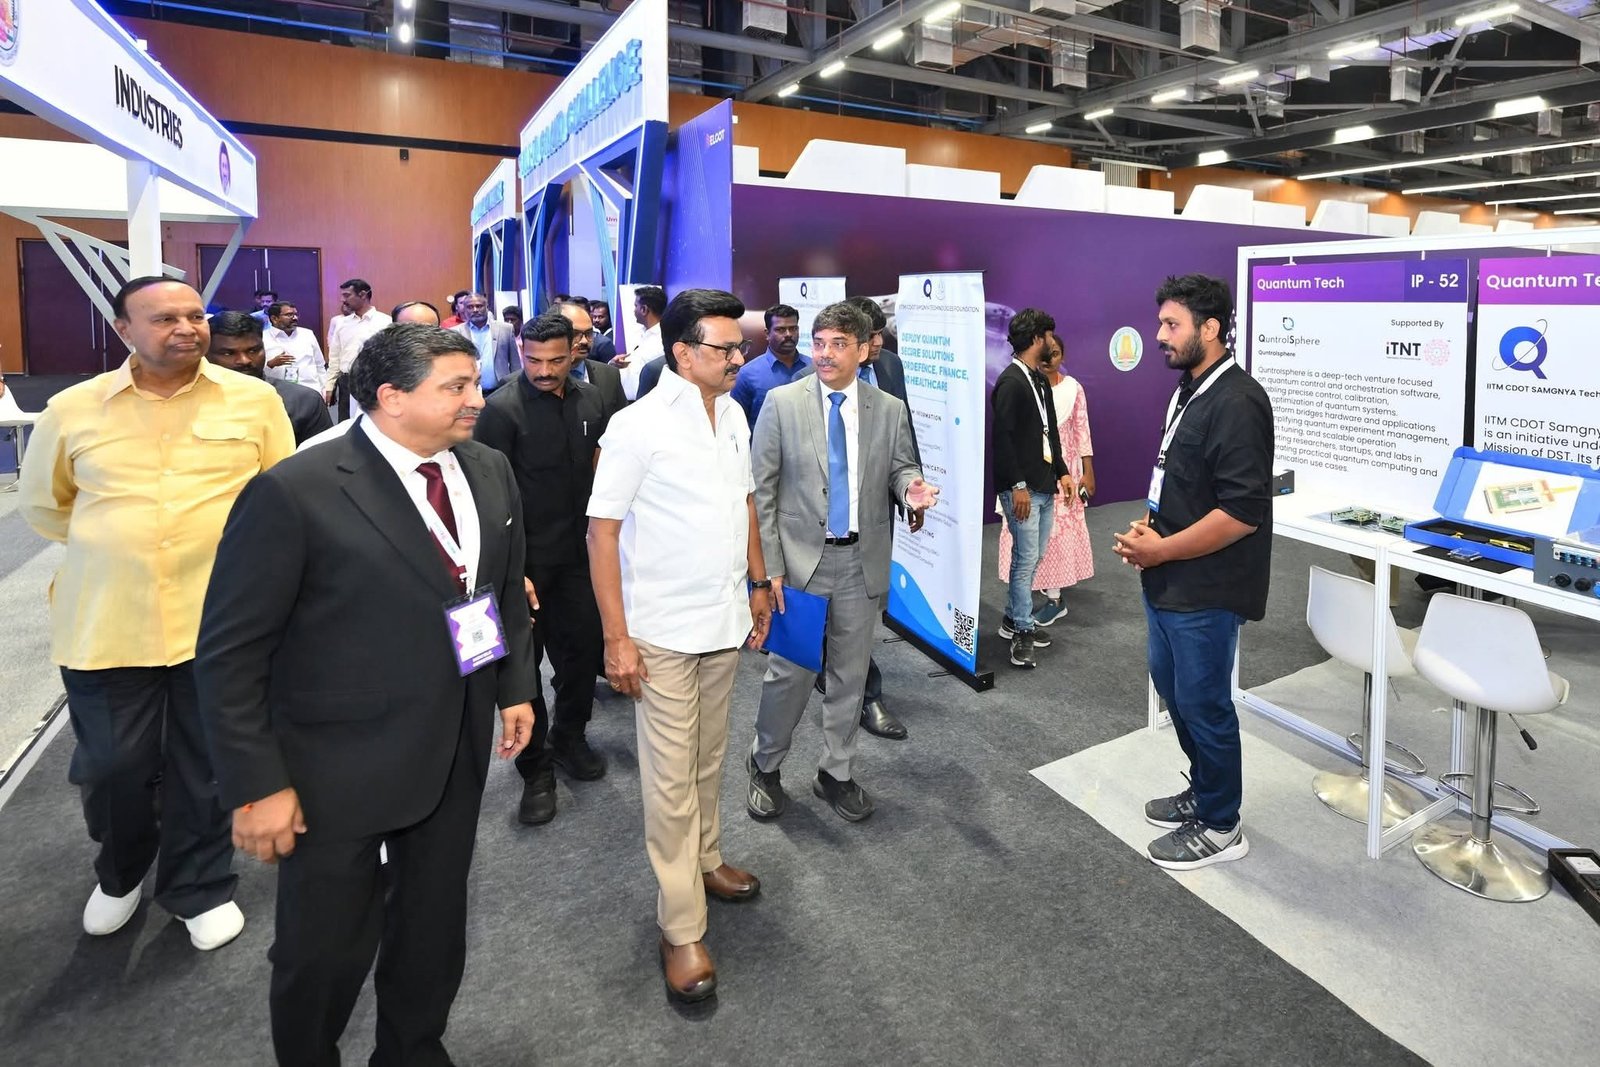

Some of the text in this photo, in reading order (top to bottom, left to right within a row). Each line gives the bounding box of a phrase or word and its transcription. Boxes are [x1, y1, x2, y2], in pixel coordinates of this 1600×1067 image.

[114, 64, 183, 149] INDUSTRIES
[1257, 276, 1345, 291] Quantum Tech
[1411, 274, 1425, 288] IP
[1439, 273, 1459, 288] 52
[1486, 274, 1578, 290] Quantum
[1391, 319, 1444, 329] Supported By
[901, 333, 951, 346] DEPLOY QUANTUM
[1258, 334, 1321, 346] QuntrolSphere
[1385, 341, 1421, 356] iTNT
[901, 347, 954, 363] SECURE SOLUTIONS
[911, 376, 948, 392] HEALTHCARE
[1258, 366, 1306, 377] Quntrolsphere
[1321, 372, 1362, 382] deep-tech
[1364, 376, 1395, 384] venture
[1397, 377, 1433, 388] focused
[1265, 387, 1287, 396] abling
[1288, 388, 1314, 397] precise
[1344, 394, 1389, 406] calibration,
[1267, 377, 1299, 385] quantum
[1300, 380, 1326, 388] control
[1327, 382, 1343, 390] and
[1344, 384, 1398, 395] orchestration
[1400, 389, 1441, 400] software,
[1505, 384, 1530, 393] CDOT
[1531, 386, 1577, 396] SAMGNYA
[1579, 390, 1600, 398] Tech
[1271, 396, 1315, 407] optimization
[1324, 403, 1360, 412] quantum
[1362, 406, 1398, 417] systems.
[1272, 406, 1436, 432] atform bridges hardware and applications
[1484, 415, 1600, 439] IITM CDOT Samgny
[1281, 425, 1305, 436] tuning,
[1306, 429, 1321, 438] and
[1322, 431, 1355, 443] scalable
[1356, 437, 1397, 449] operation
[1304, 420, 1338, 429] quantum
[1340, 424, 1385, 437] experiment
[1386, 430, 1450, 446] management,
[1484, 428, 1600, 451] is an initiative und
[1292, 437, 1338, 450] researchers,
[1339, 443, 1373, 456] startups,
[1375, 449, 1391, 459] and
[1393, 451, 1412, 462] labs
[1413, 454, 1422, 463] in
[1483, 442, 1528, 456] Mission
[1531, 447, 1544, 457] of
[1547, 449, 1574, 462] DST.
[1577, 453, 1592, 464] Its
[1299, 447, 1332, 459] practical
[1333, 453, 1369, 465] quantum
[1371, 459, 1418, 476] computing
[1419, 467, 1438, 477] and
[1310, 460, 1323, 468] use
